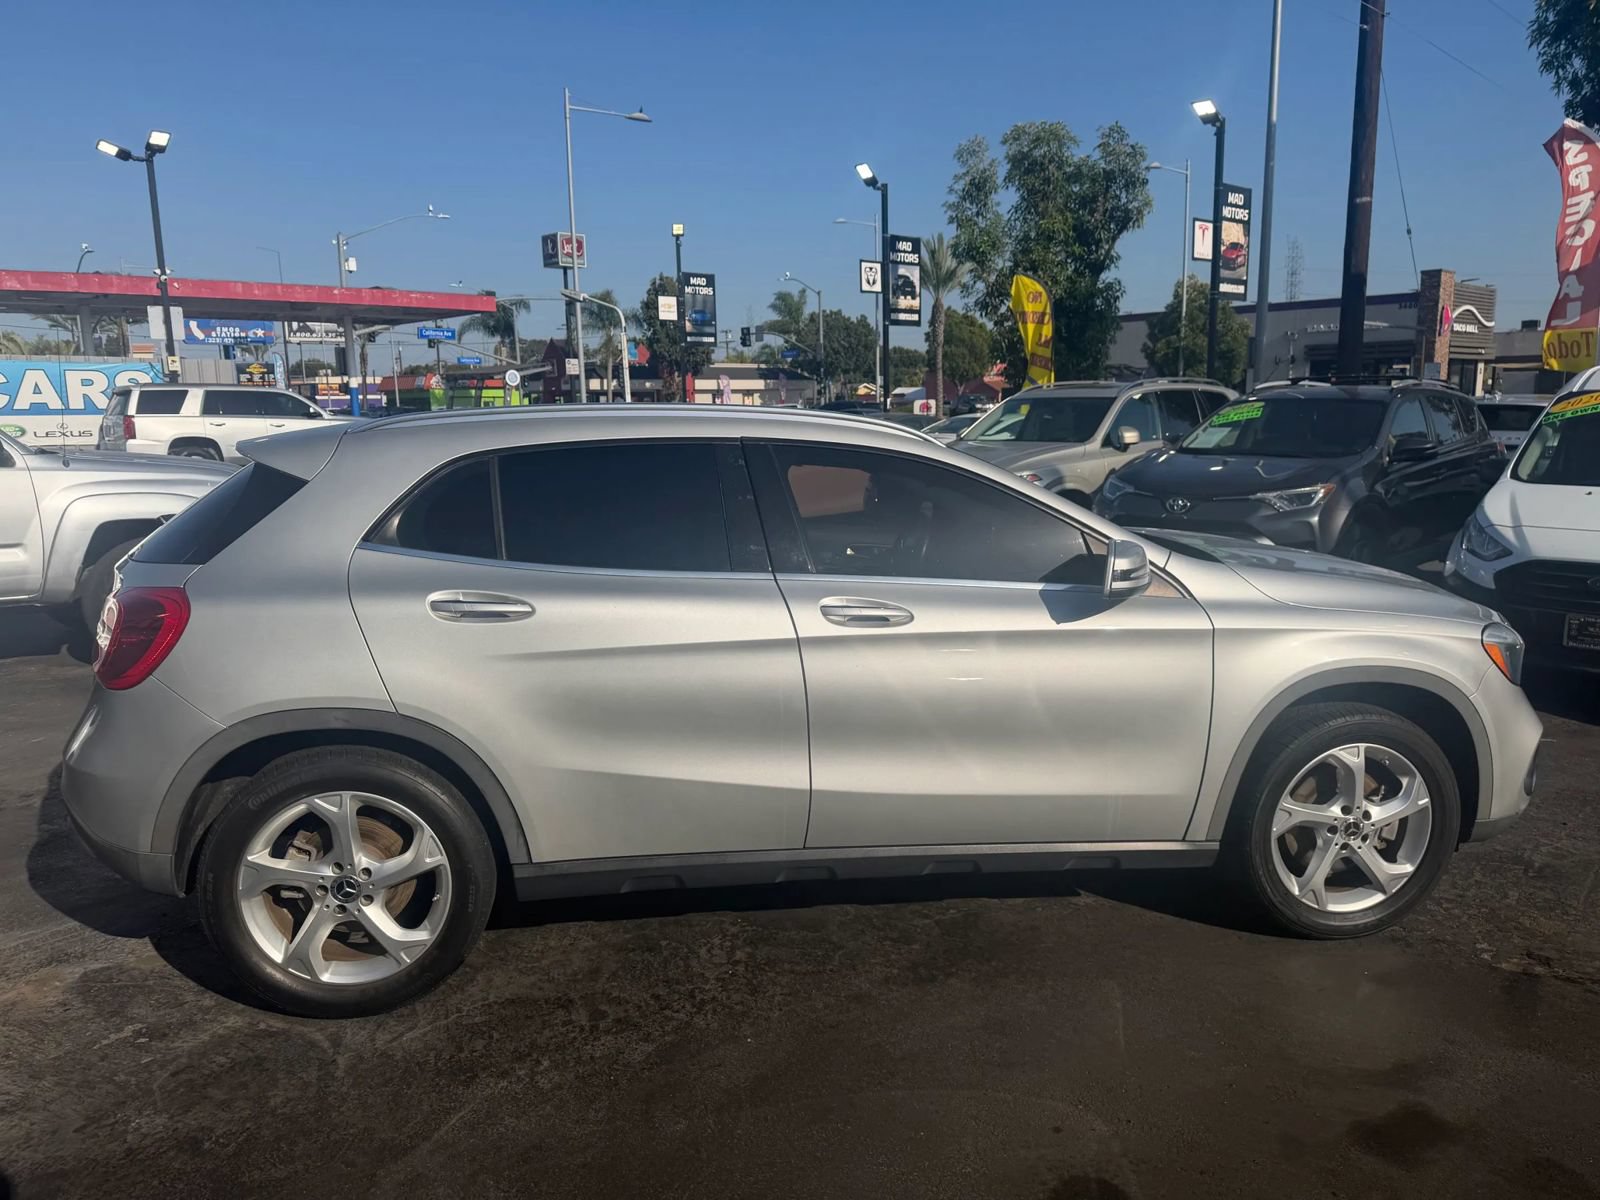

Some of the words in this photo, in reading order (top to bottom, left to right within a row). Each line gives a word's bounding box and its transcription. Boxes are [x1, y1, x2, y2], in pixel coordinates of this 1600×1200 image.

[1228, 191, 1244, 206] MAD
[1222, 205, 1249, 221] MOTORS
[895, 241, 912, 252] MAD
[890, 251, 919, 263] MOTORS
[690, 276, 707, 286] MAD
[684, 285, 714, 296] MOTORS
[0, 369, 153, 410] AR
[33, 430, 93, 438] LEXUS
